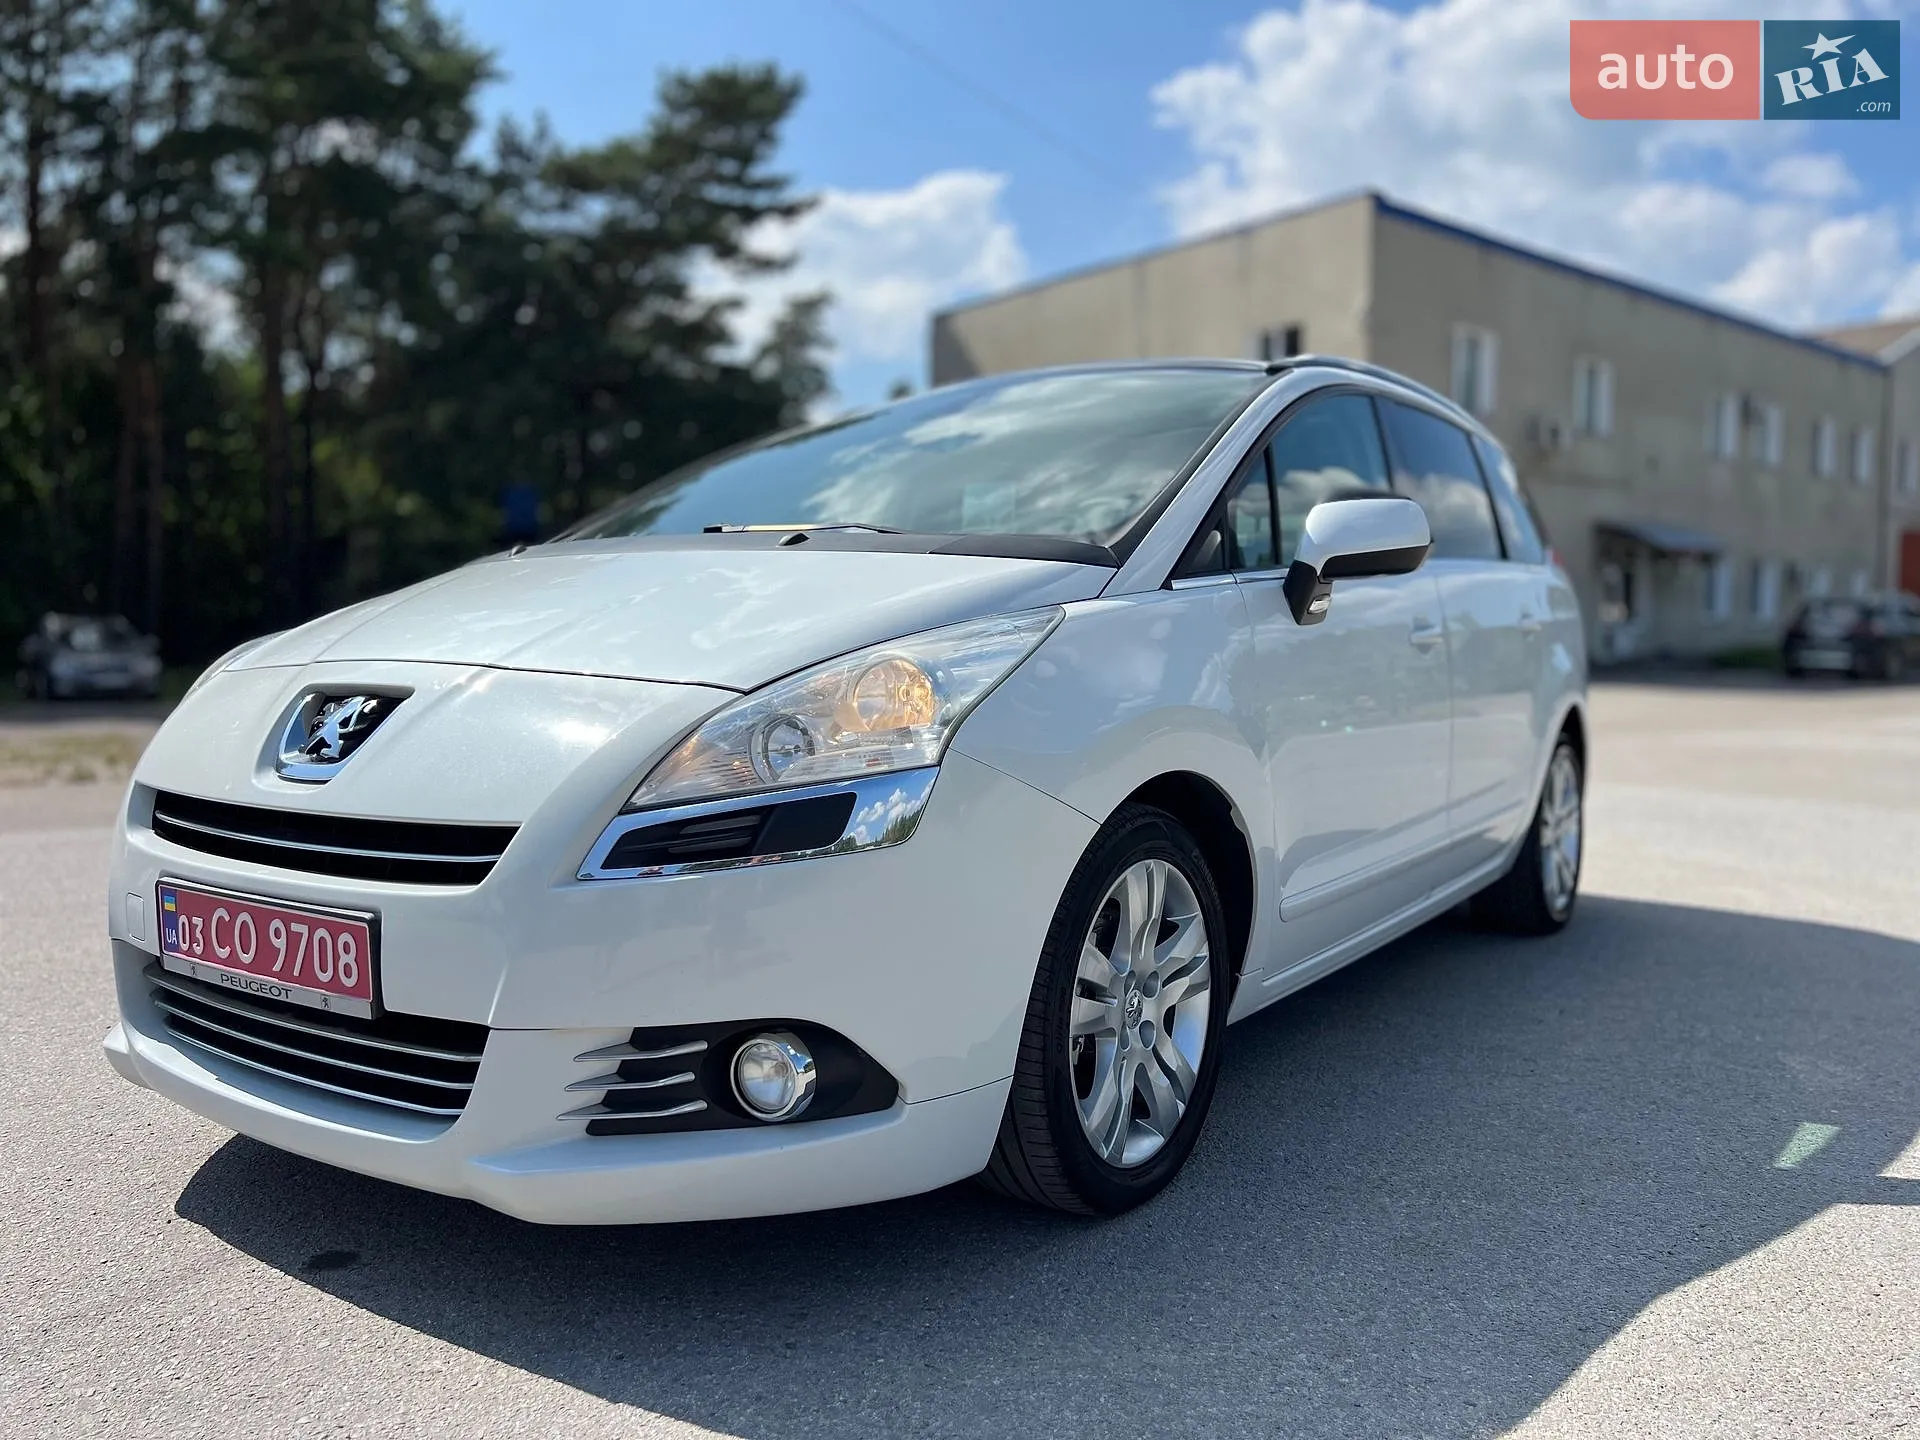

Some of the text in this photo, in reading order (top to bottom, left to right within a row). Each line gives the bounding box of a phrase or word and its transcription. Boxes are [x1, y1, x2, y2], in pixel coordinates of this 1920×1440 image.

[166, 927, 178, 945] UA
[178, 907, 359, 987] 03 CO 9708
[220, 973, 293, 1000] PEUGEOT
